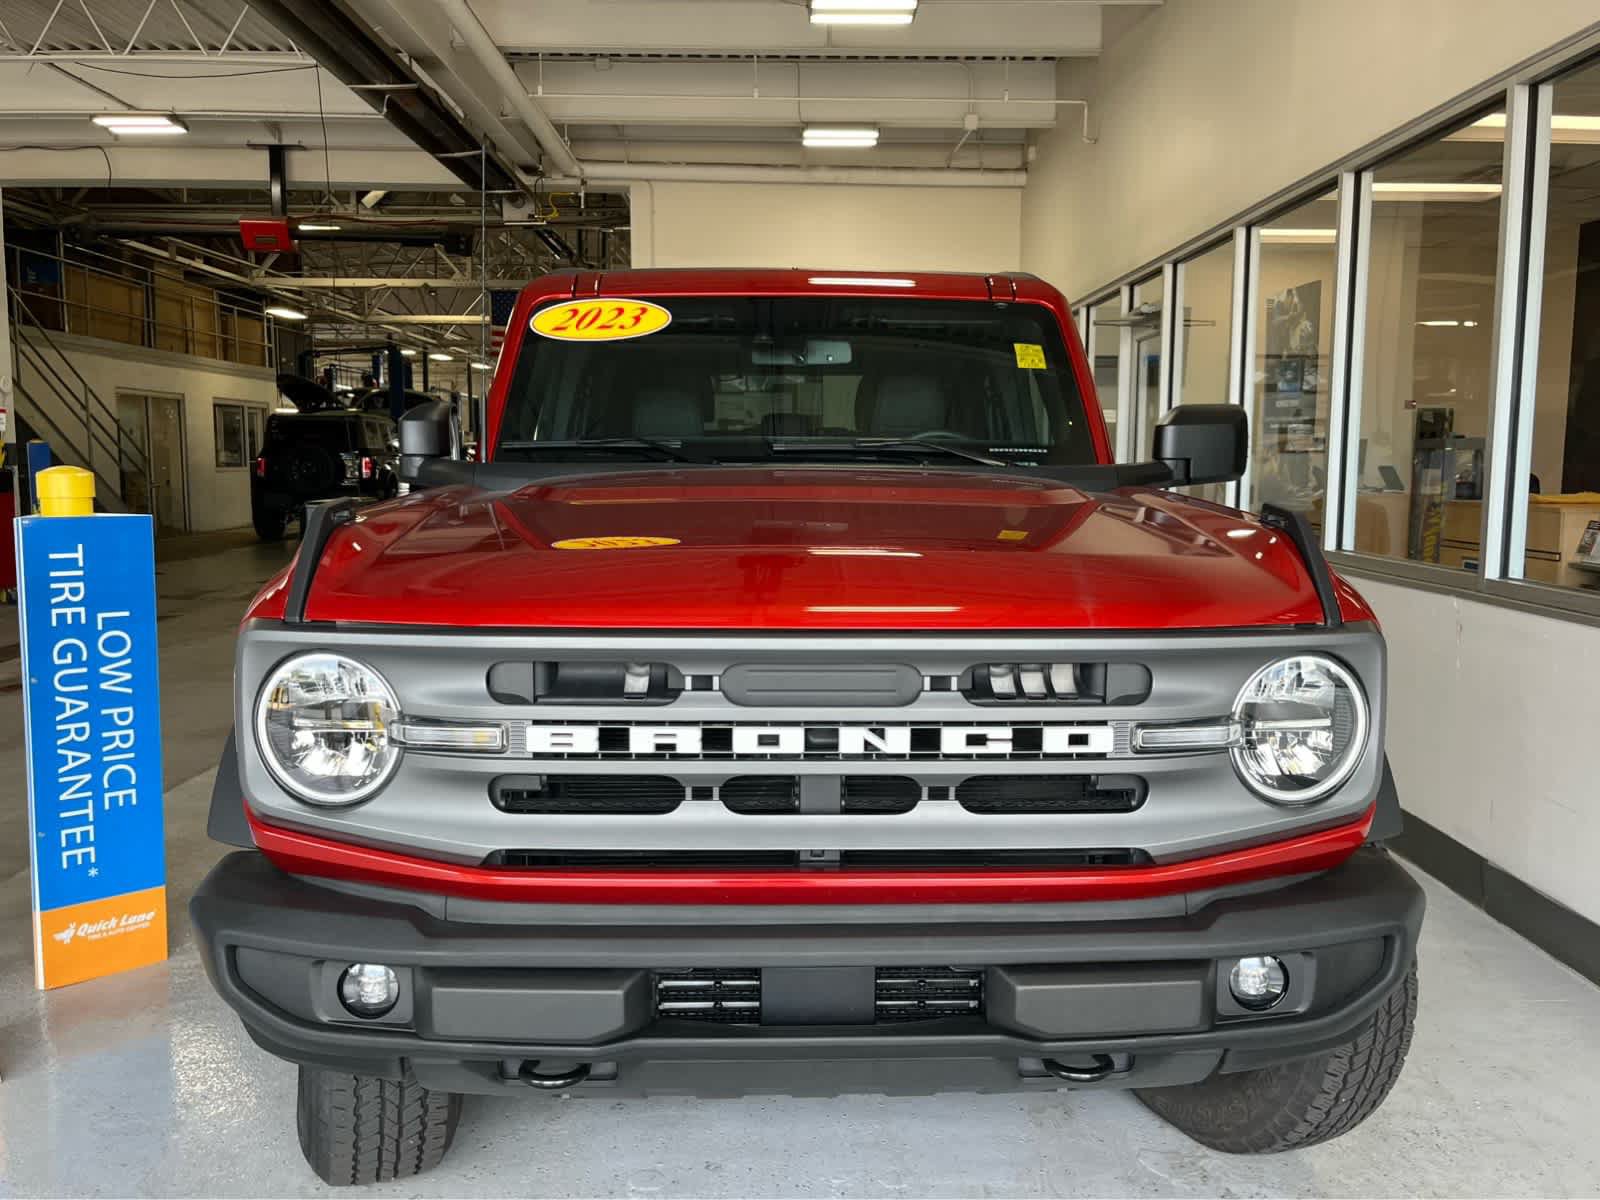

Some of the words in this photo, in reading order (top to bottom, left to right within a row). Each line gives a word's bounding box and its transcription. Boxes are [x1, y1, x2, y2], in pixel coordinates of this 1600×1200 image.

[551, 306, 649, 332] 2023
[48, 543, 87, 627] TIRE
[97, 610, 133, 694] LOW
[100, 706, 137, 811] PRICE
[525, 725, 1114, 753] BRONCO
[76, 916, 118, 937] Quick
[119, 911, 156, 927] Lane
